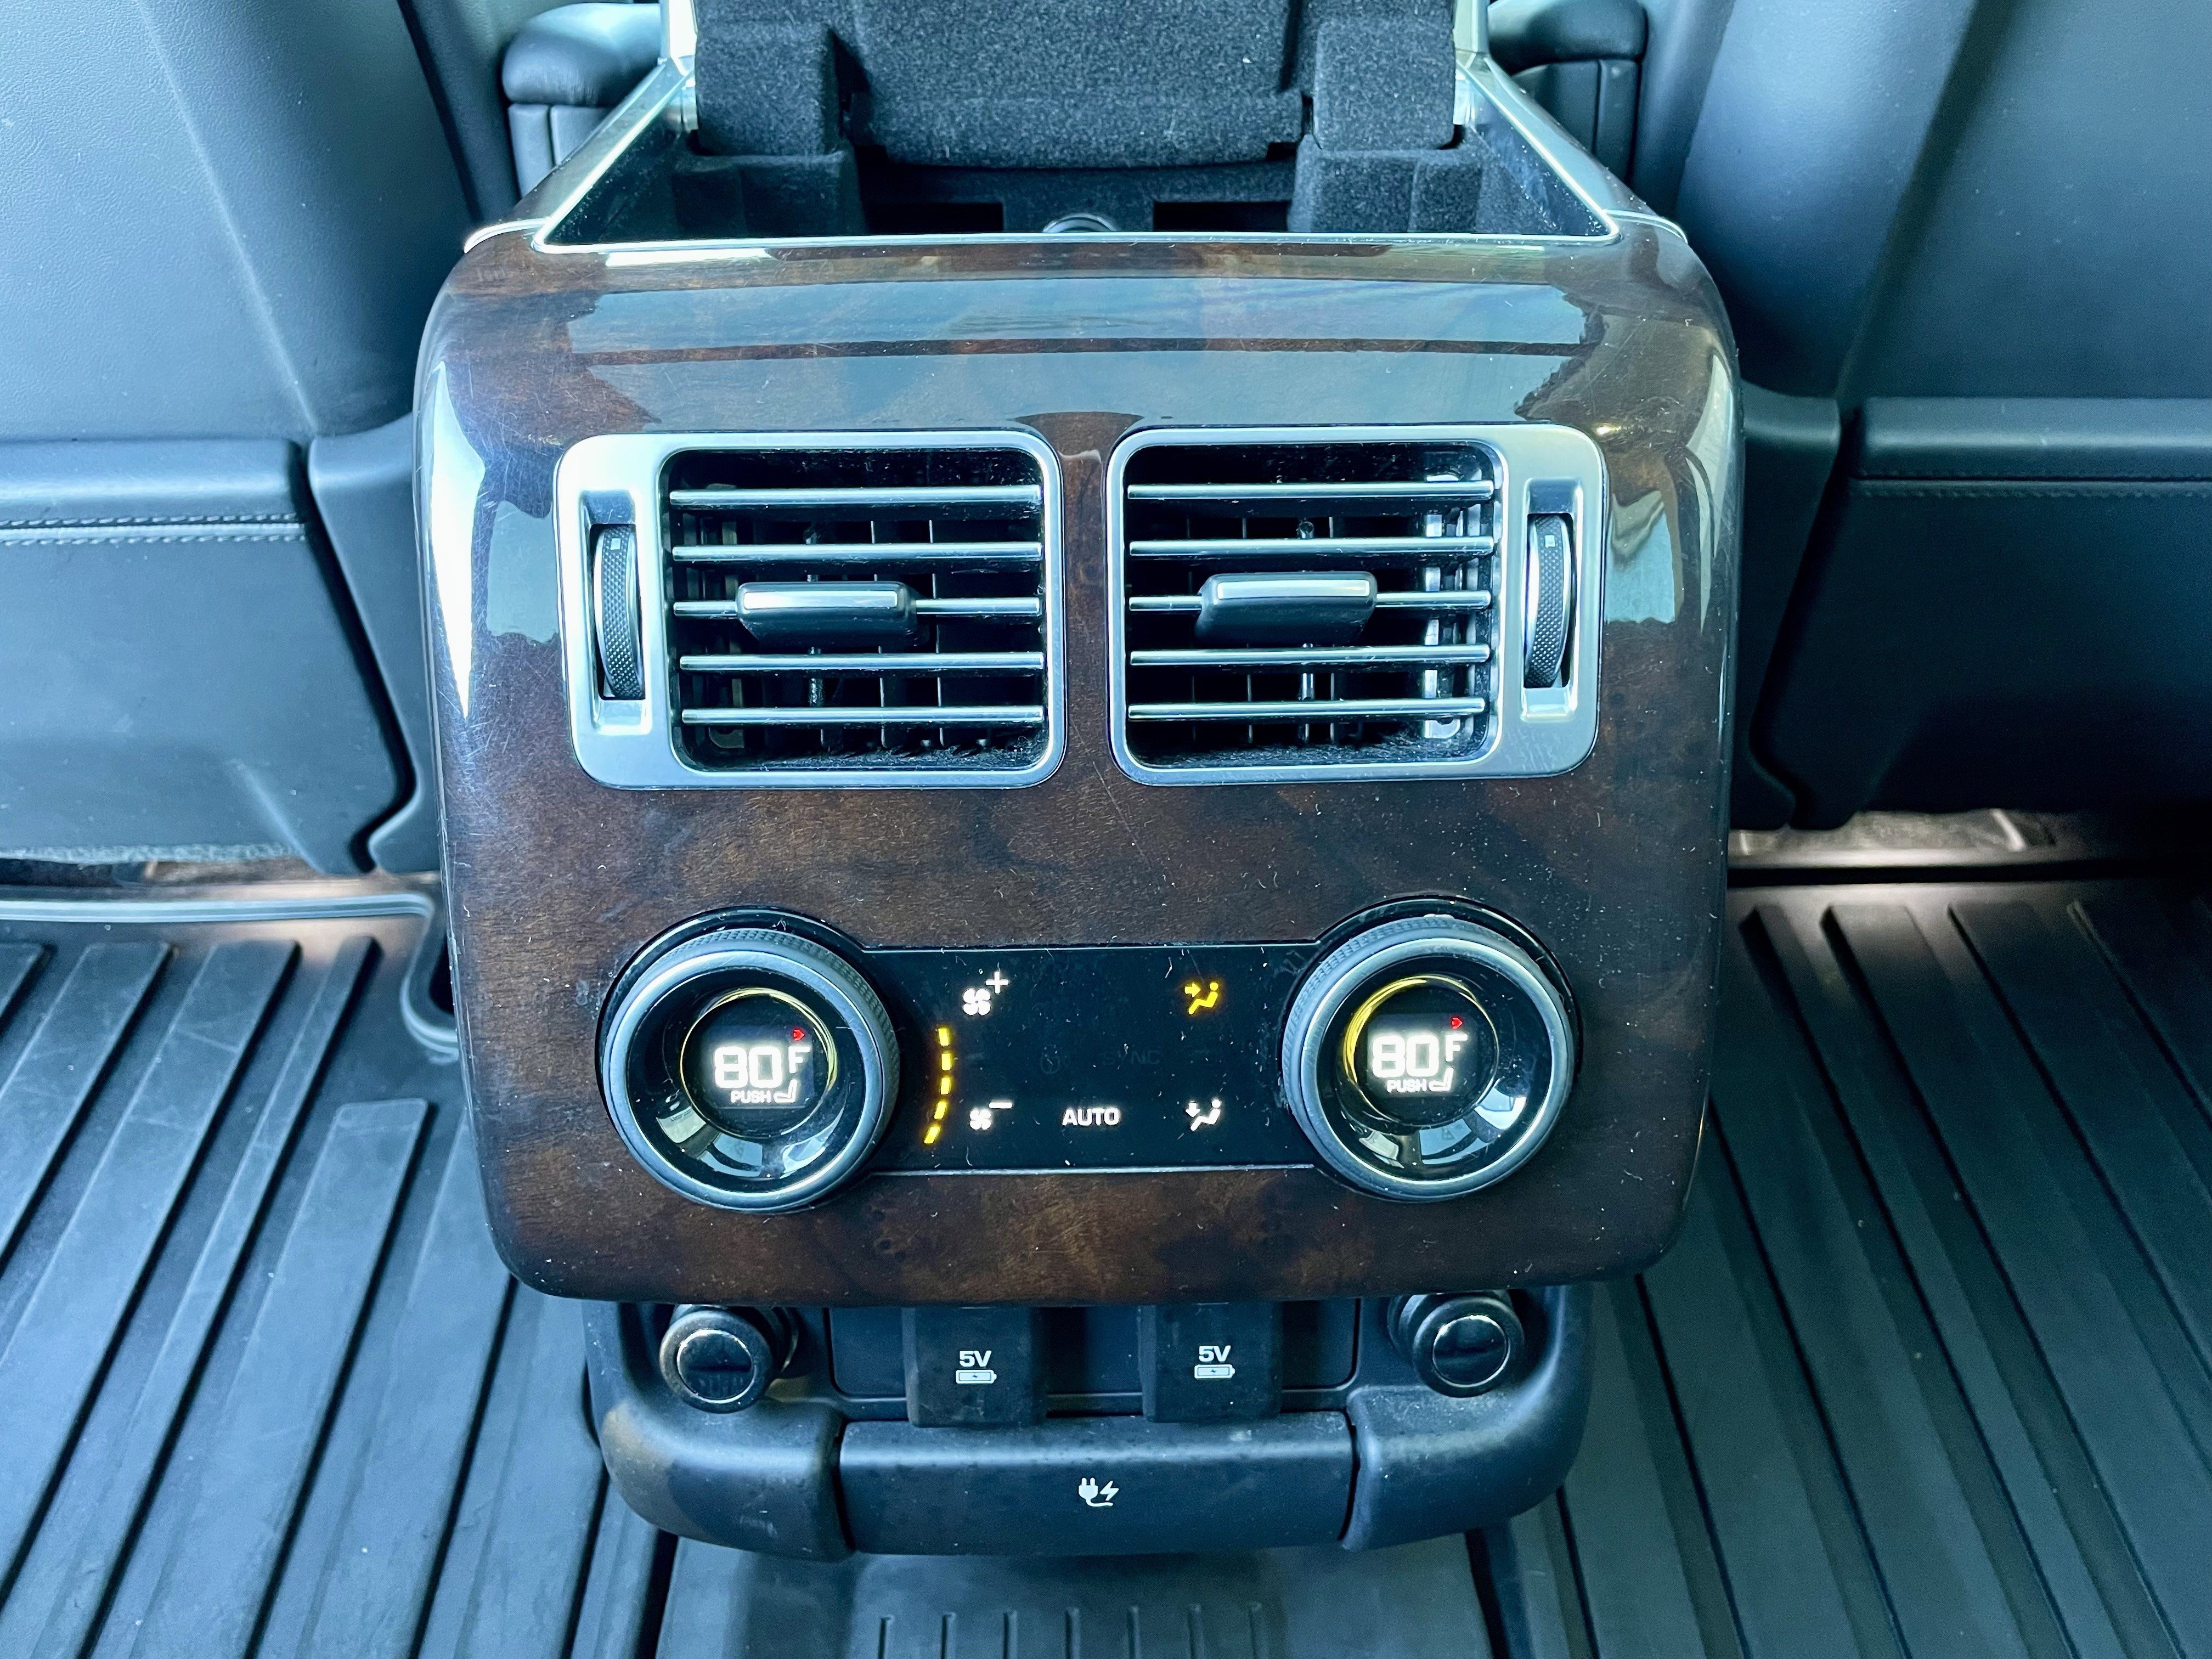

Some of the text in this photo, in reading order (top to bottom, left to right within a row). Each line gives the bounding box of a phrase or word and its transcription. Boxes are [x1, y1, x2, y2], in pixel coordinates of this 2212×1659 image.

[1387, 1079, 1427, 1093] PUSH
[730, 1090, 771, 1104] PUSH
[1062, 1107, 1120, 1126] AUTO
[958, 1350, 992, 1368] 5V
[1198, 1345, 1231, 1363] 5V
